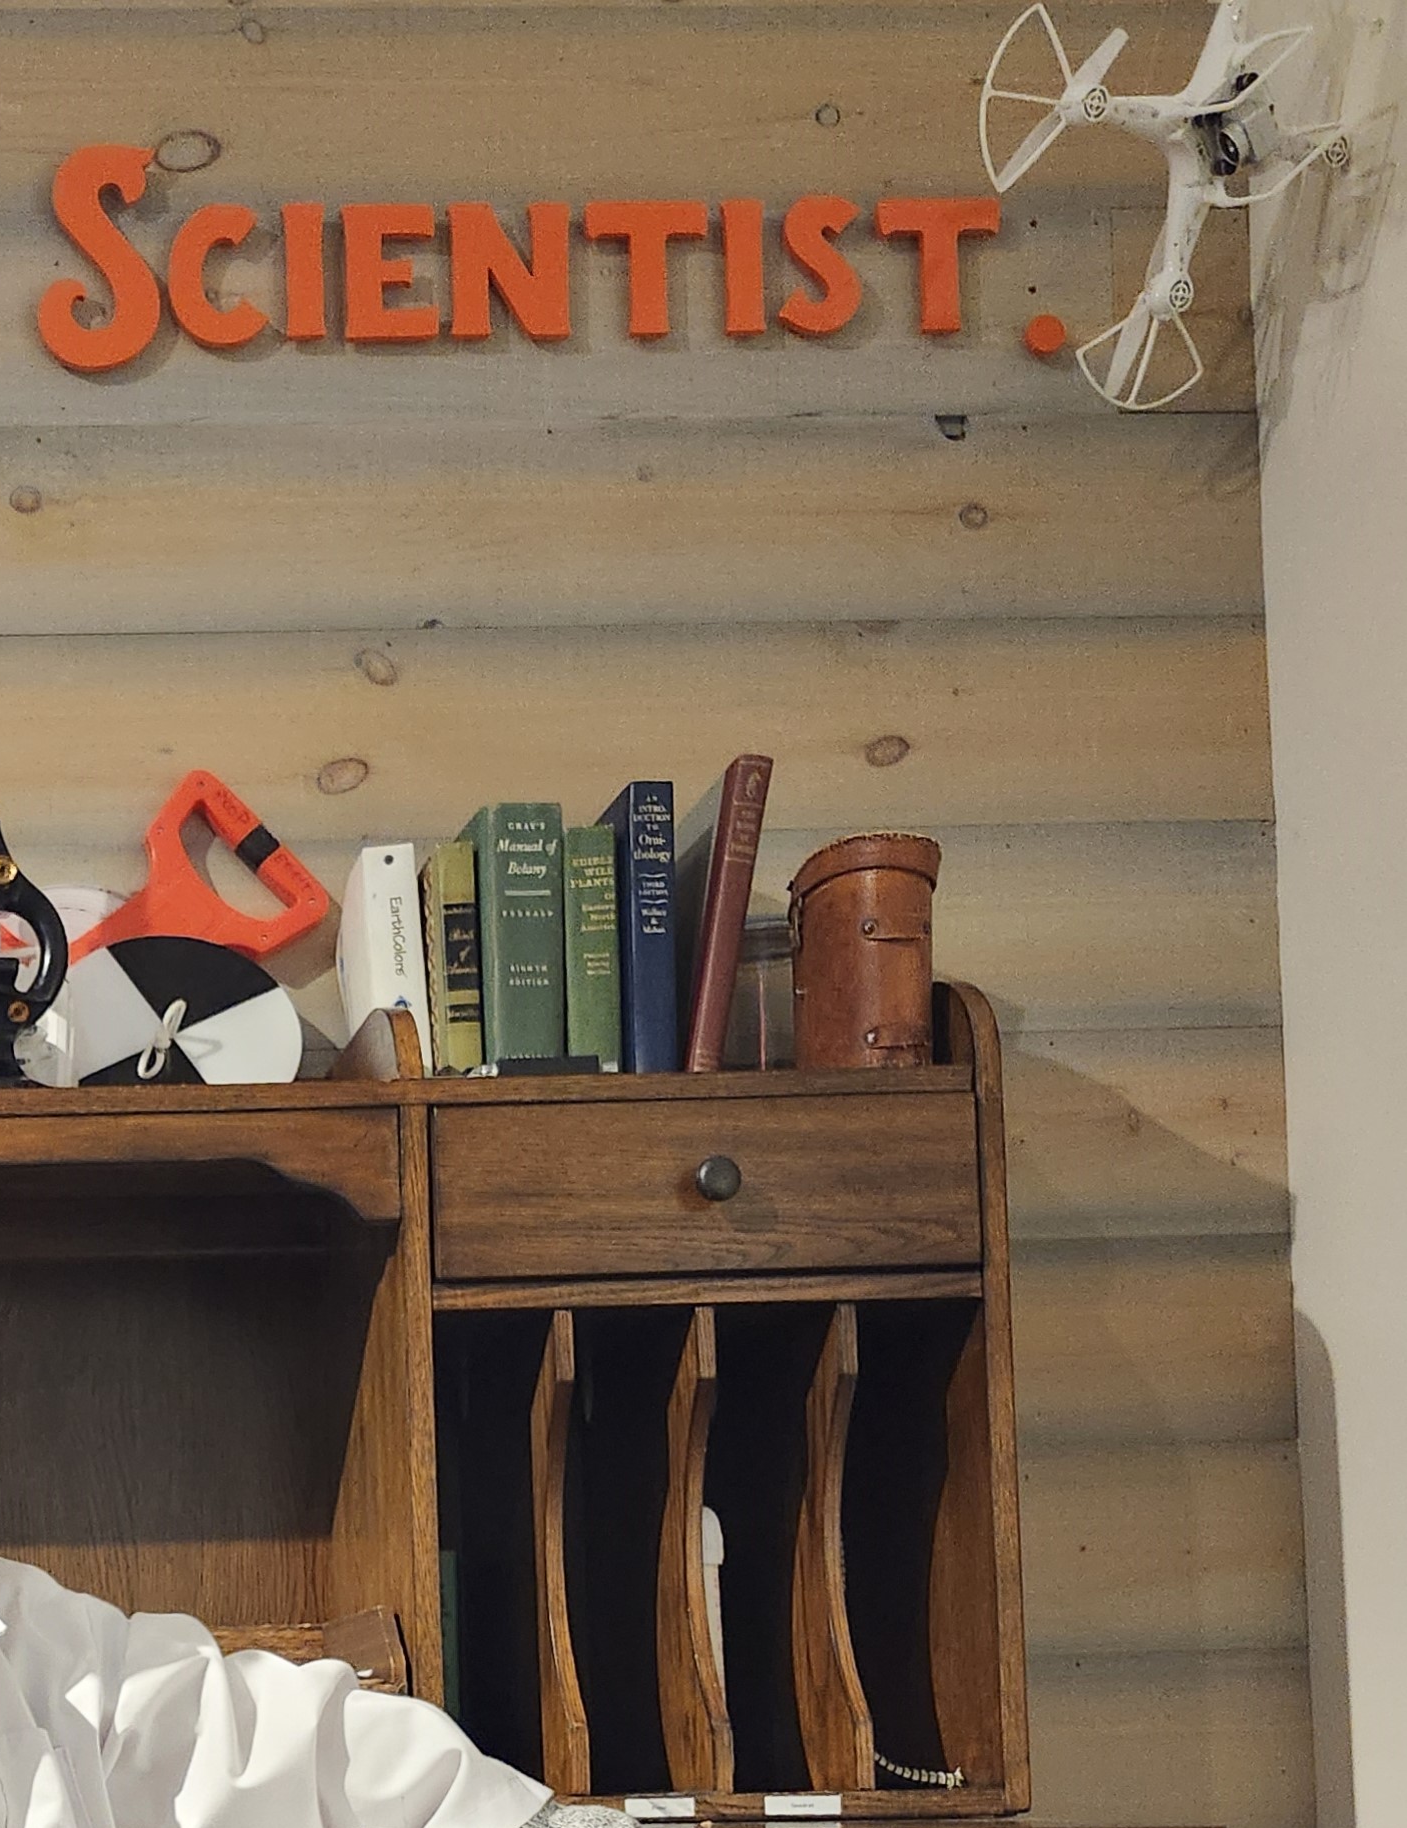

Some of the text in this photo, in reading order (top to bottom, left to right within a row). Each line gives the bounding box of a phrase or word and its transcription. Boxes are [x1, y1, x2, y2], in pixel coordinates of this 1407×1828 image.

[496, 838, 559, 857] Manual of
[507, 861, 547, 879] Botany
